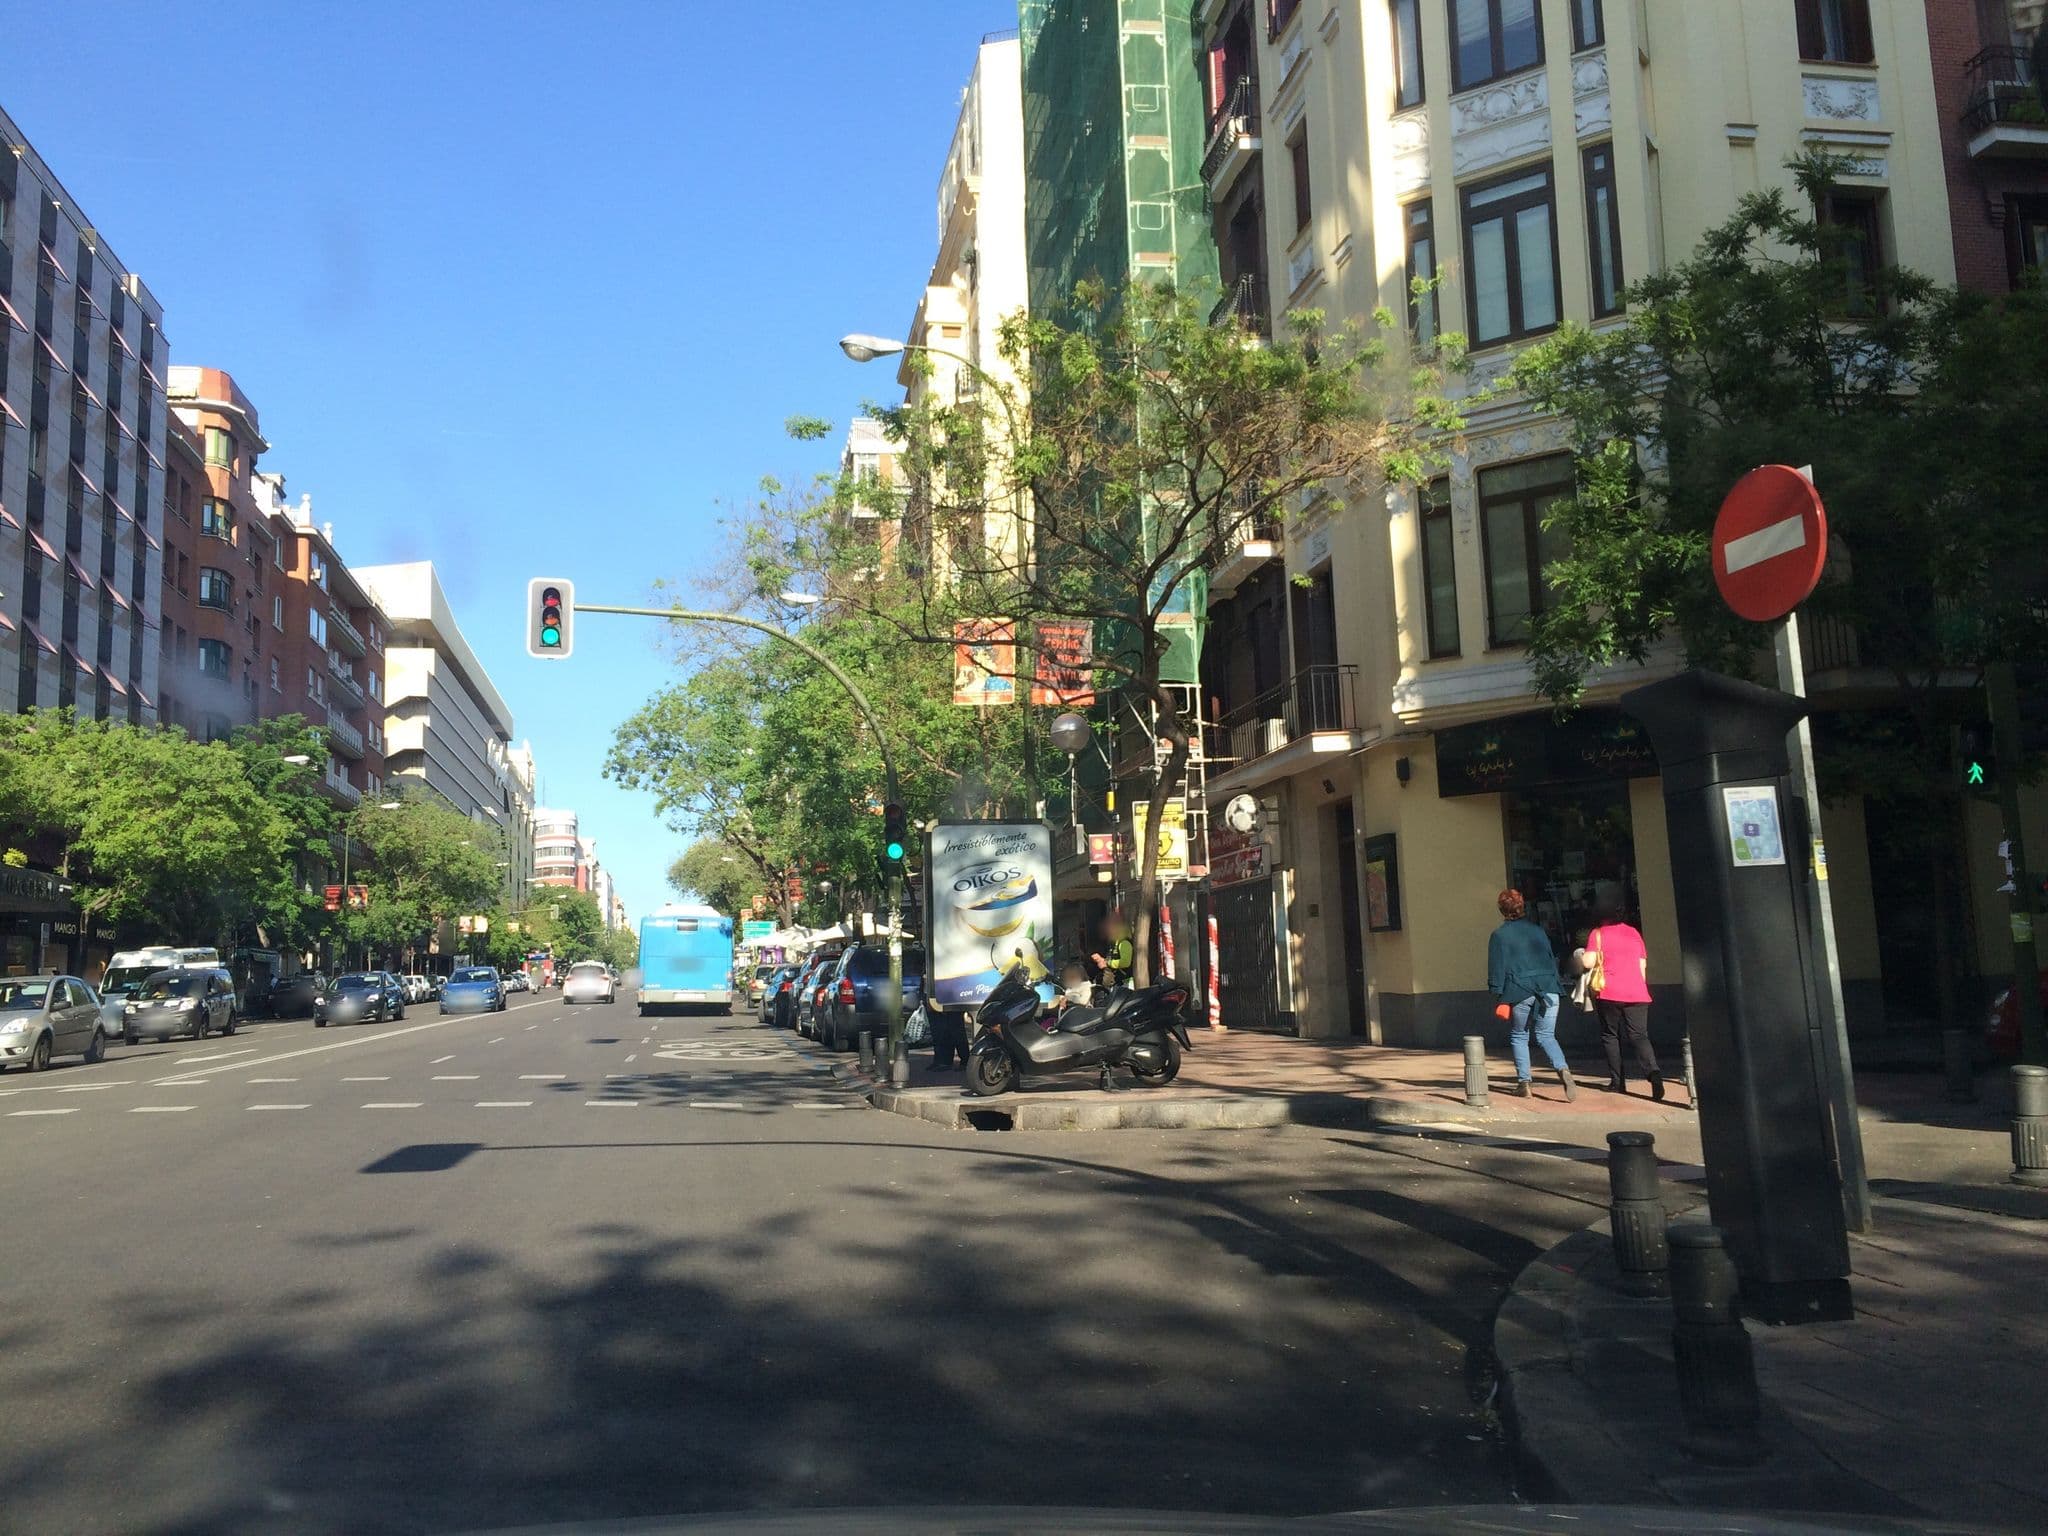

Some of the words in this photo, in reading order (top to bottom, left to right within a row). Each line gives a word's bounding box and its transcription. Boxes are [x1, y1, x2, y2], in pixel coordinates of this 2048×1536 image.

[943, 831, 1027, 854] Irresistiblemente
[995, 840, 1036, 857] exótico
[953, 867, 1021, 892] OIKOS
[54, 921, 77, 935] MANGO
[96, 928, 116, 940] MANGO
